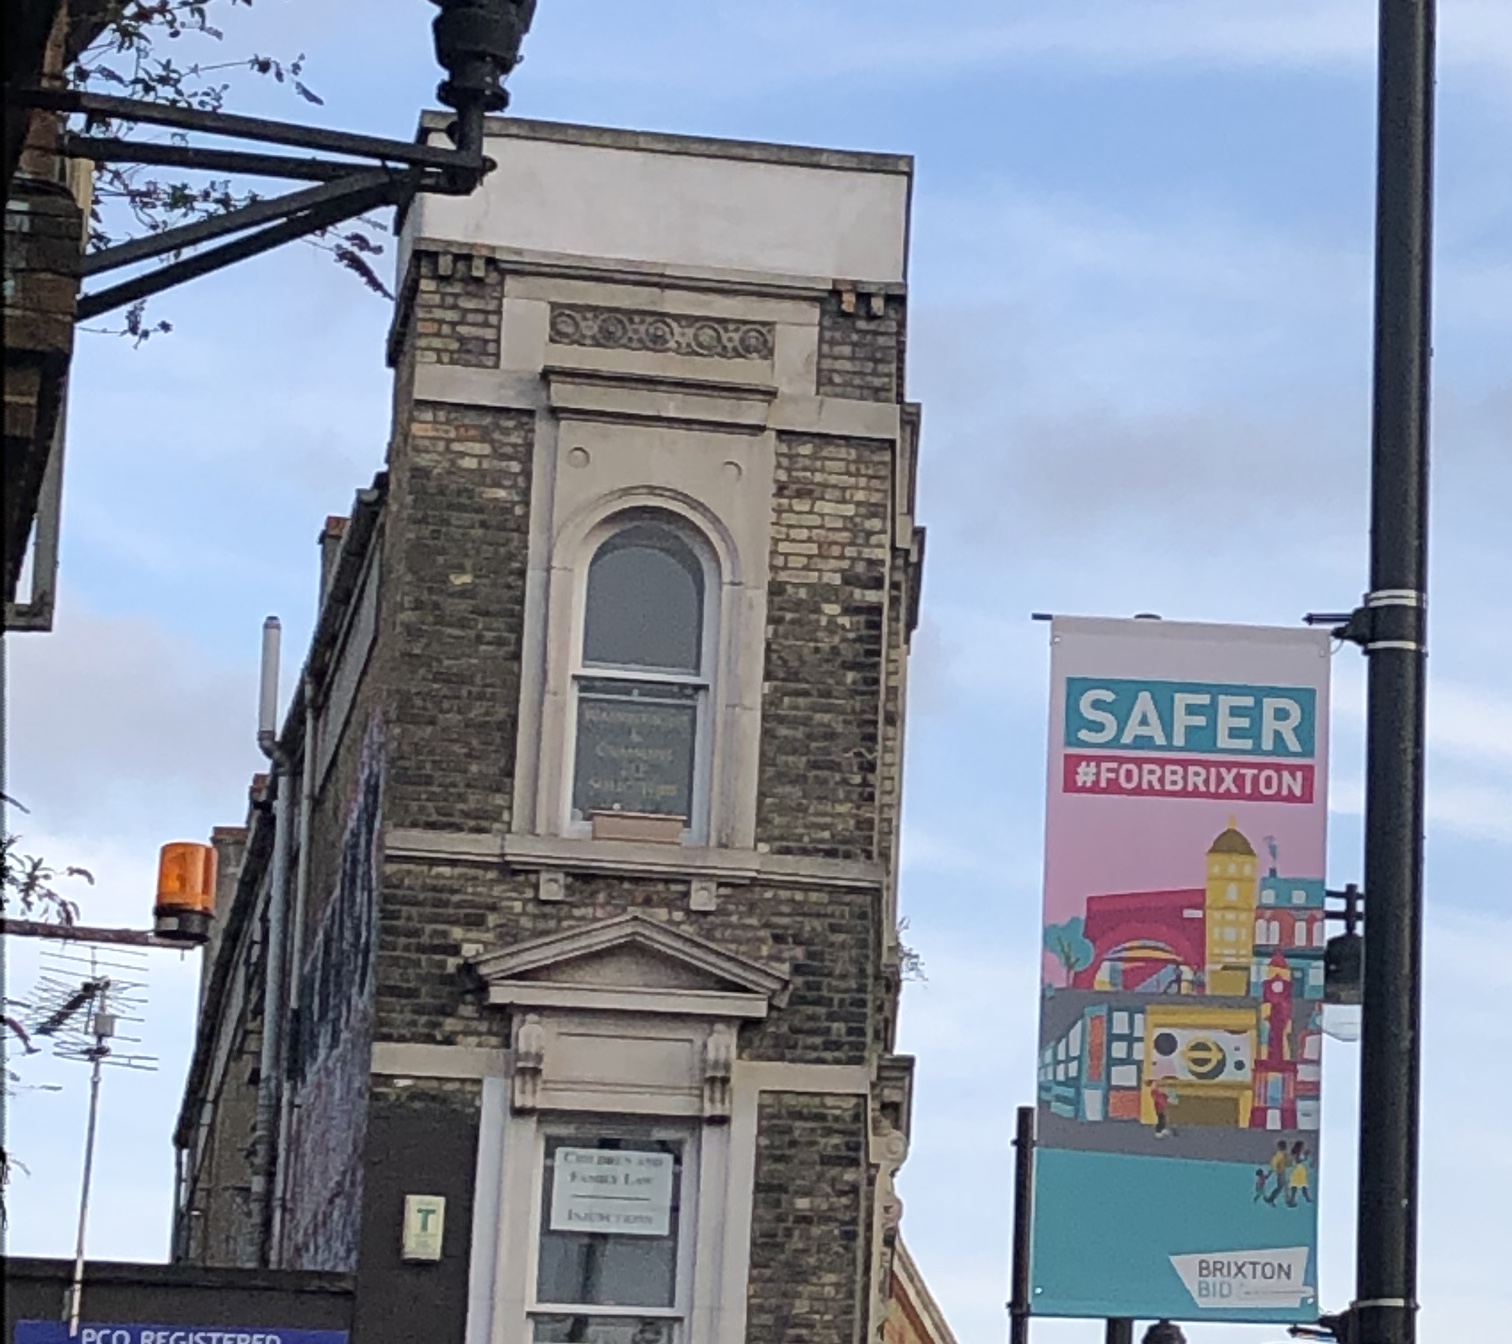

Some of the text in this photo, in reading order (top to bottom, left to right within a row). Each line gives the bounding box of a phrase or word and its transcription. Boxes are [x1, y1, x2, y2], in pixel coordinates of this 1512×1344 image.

[1077, 688, 1303, 753] SAFER
[1075, 760, 1303, 797] #FORBRIXTON
[1198, 1258, 1293, 1280] BRIXTON
[1197, 1280, 1233, 1299] BID
